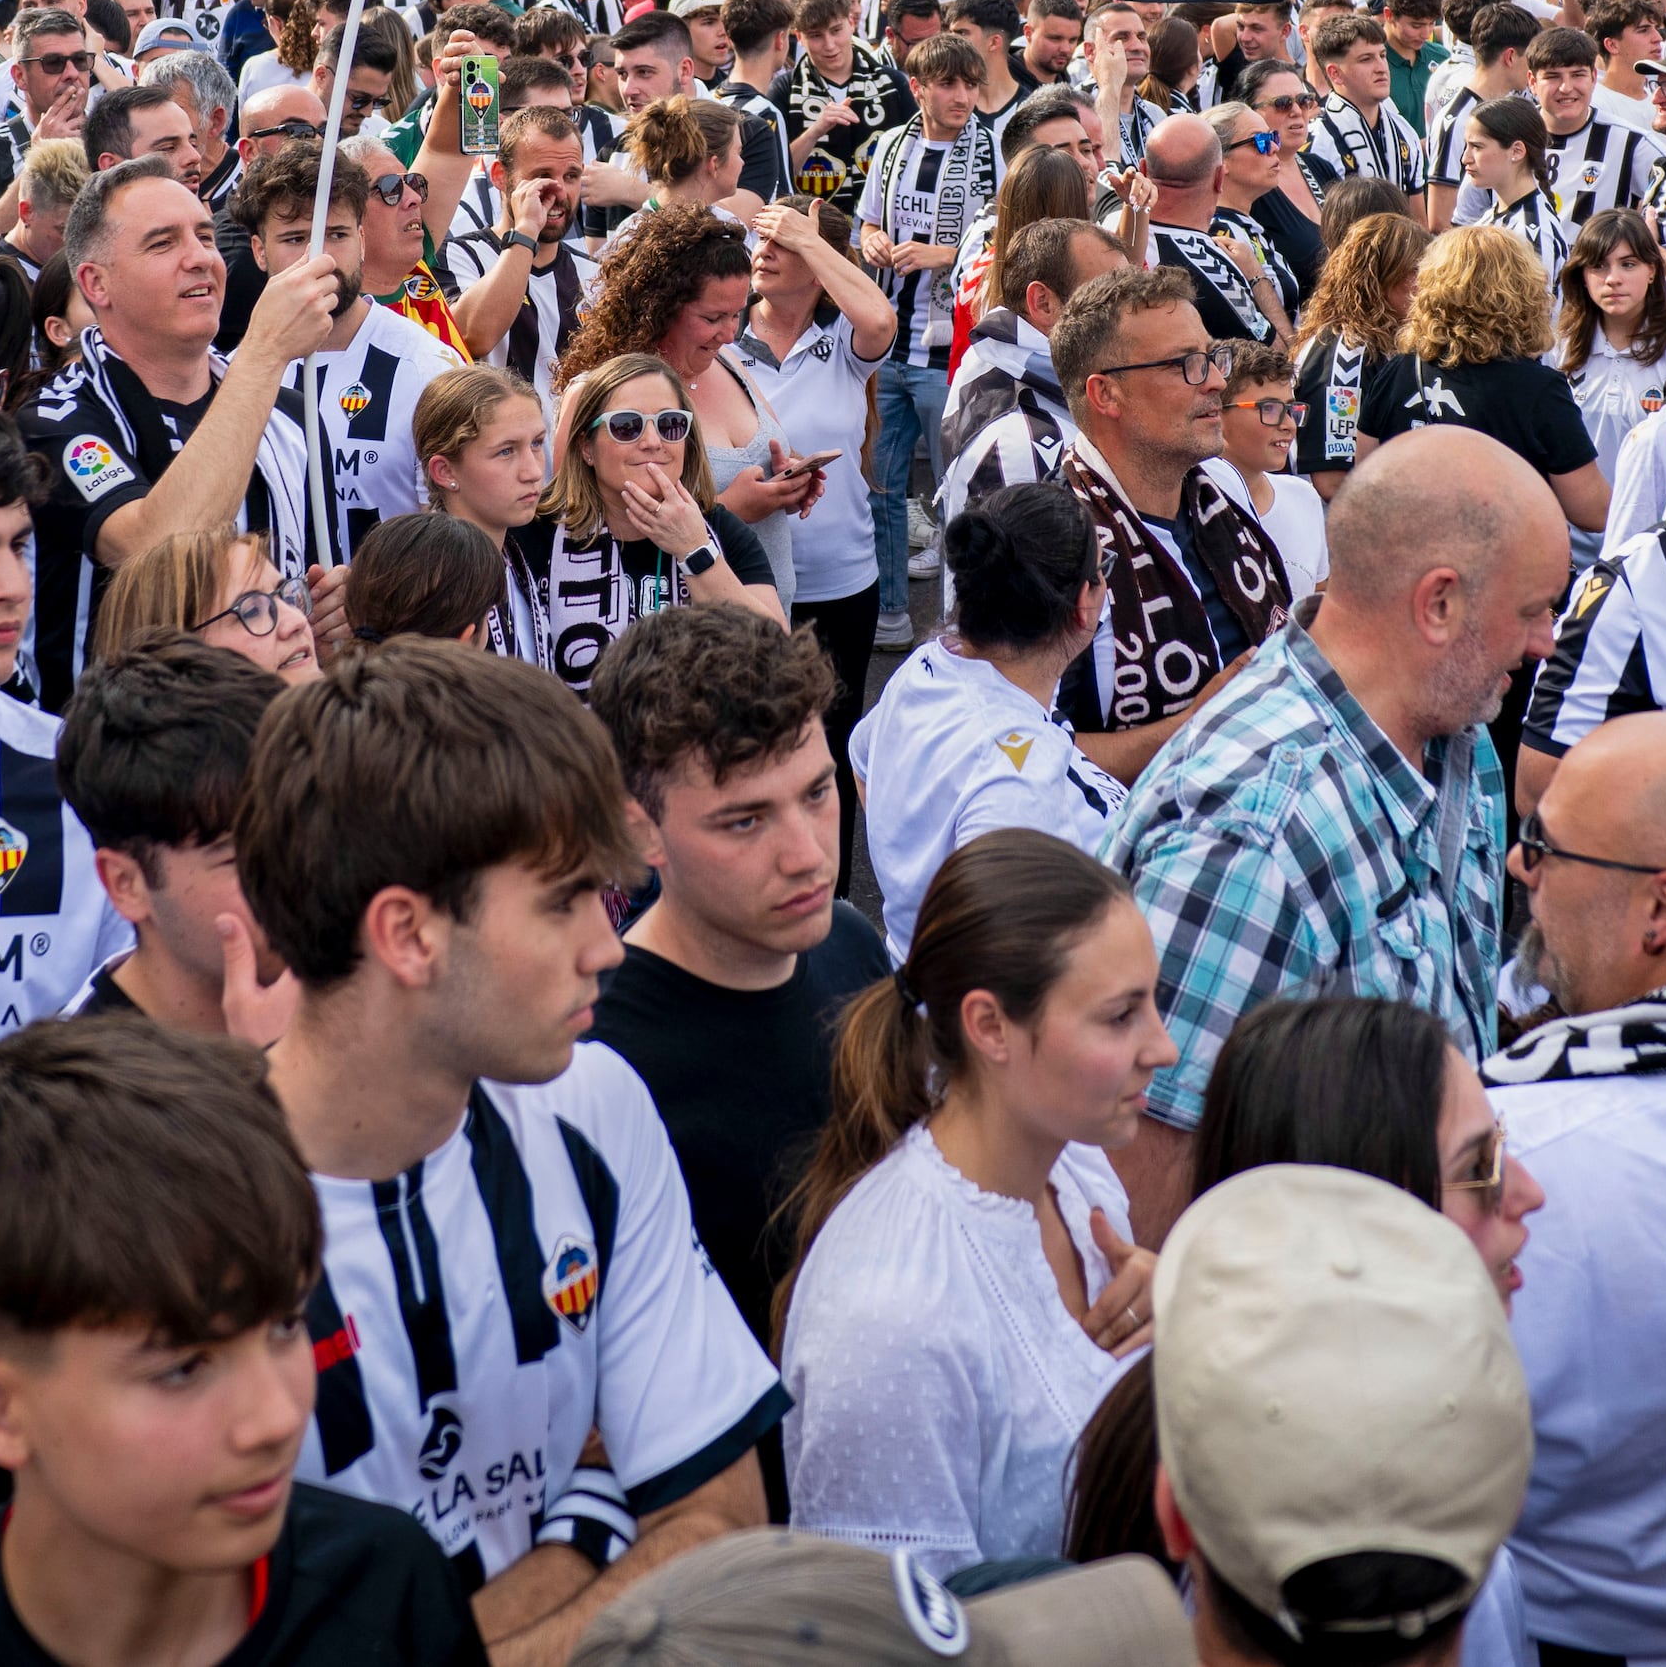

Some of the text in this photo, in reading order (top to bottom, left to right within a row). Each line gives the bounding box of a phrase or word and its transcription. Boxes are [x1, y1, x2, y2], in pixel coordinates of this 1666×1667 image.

[1329, 419, 1354, 435] LFP
[1327, 442, 1355, 454] BBVA
[85, 466, 126, 492] LaLiga
[434, 1474, 475, 1520] LA
